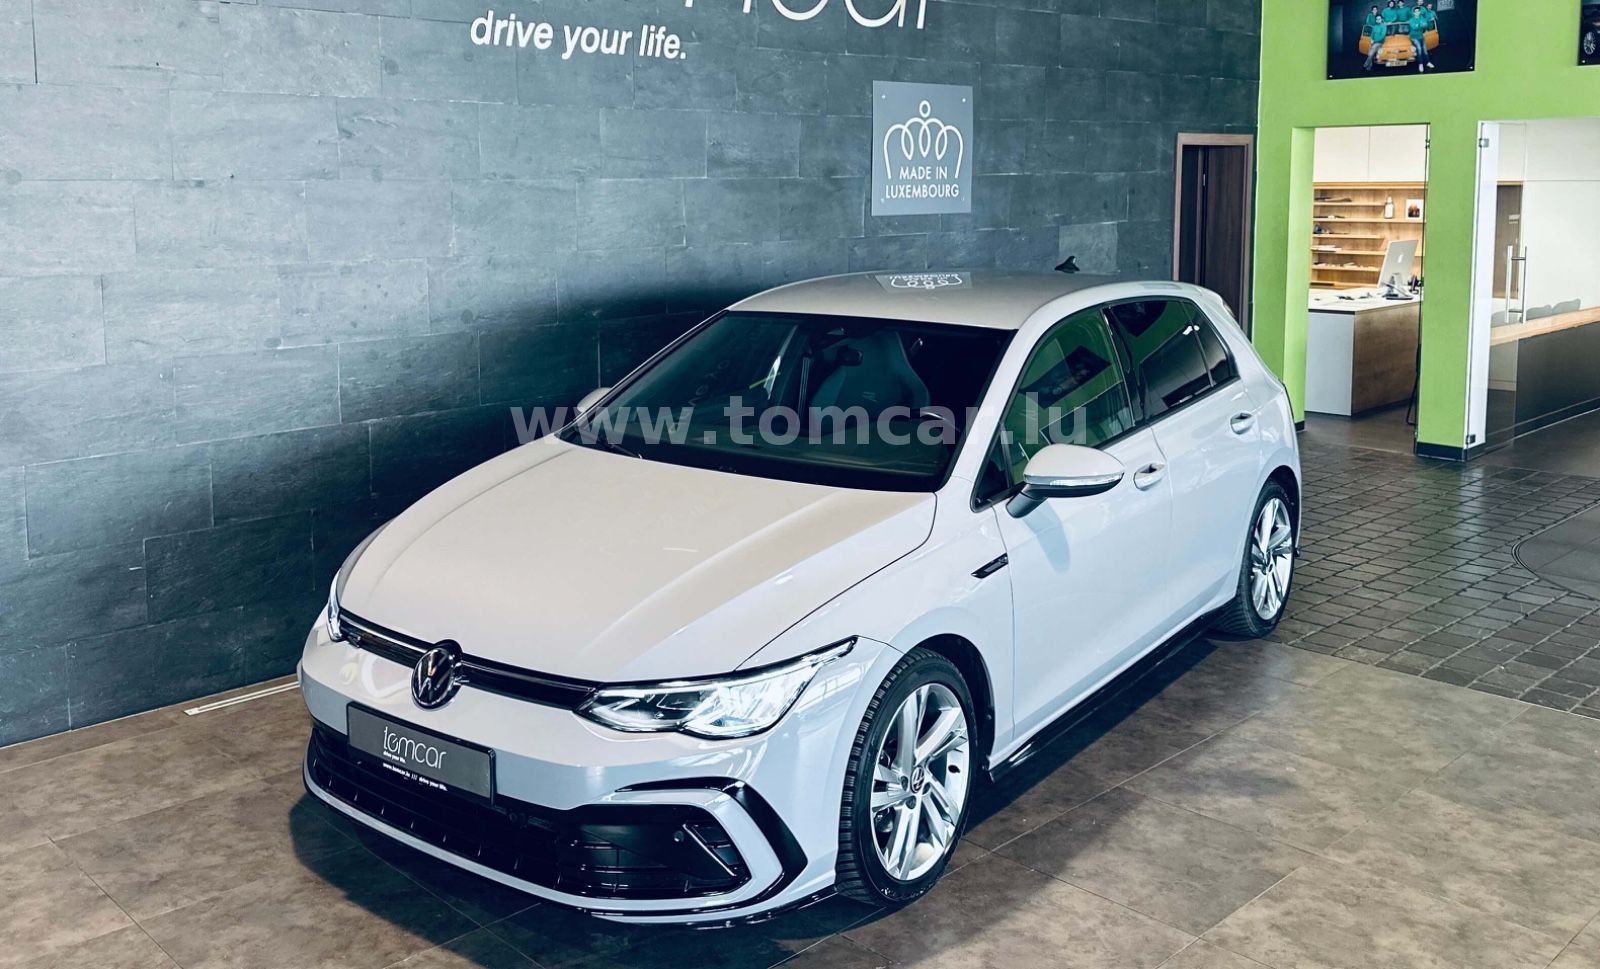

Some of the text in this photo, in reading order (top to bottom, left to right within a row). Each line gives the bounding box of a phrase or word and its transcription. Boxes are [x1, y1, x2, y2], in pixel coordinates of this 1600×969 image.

[470, 10, 686, 60] drive your life.
[899, 166, 948, 180] MADE IN
[885, 183, 960, 199] LUXEMBOURG
[383, 726, 447, 769] tomcar
